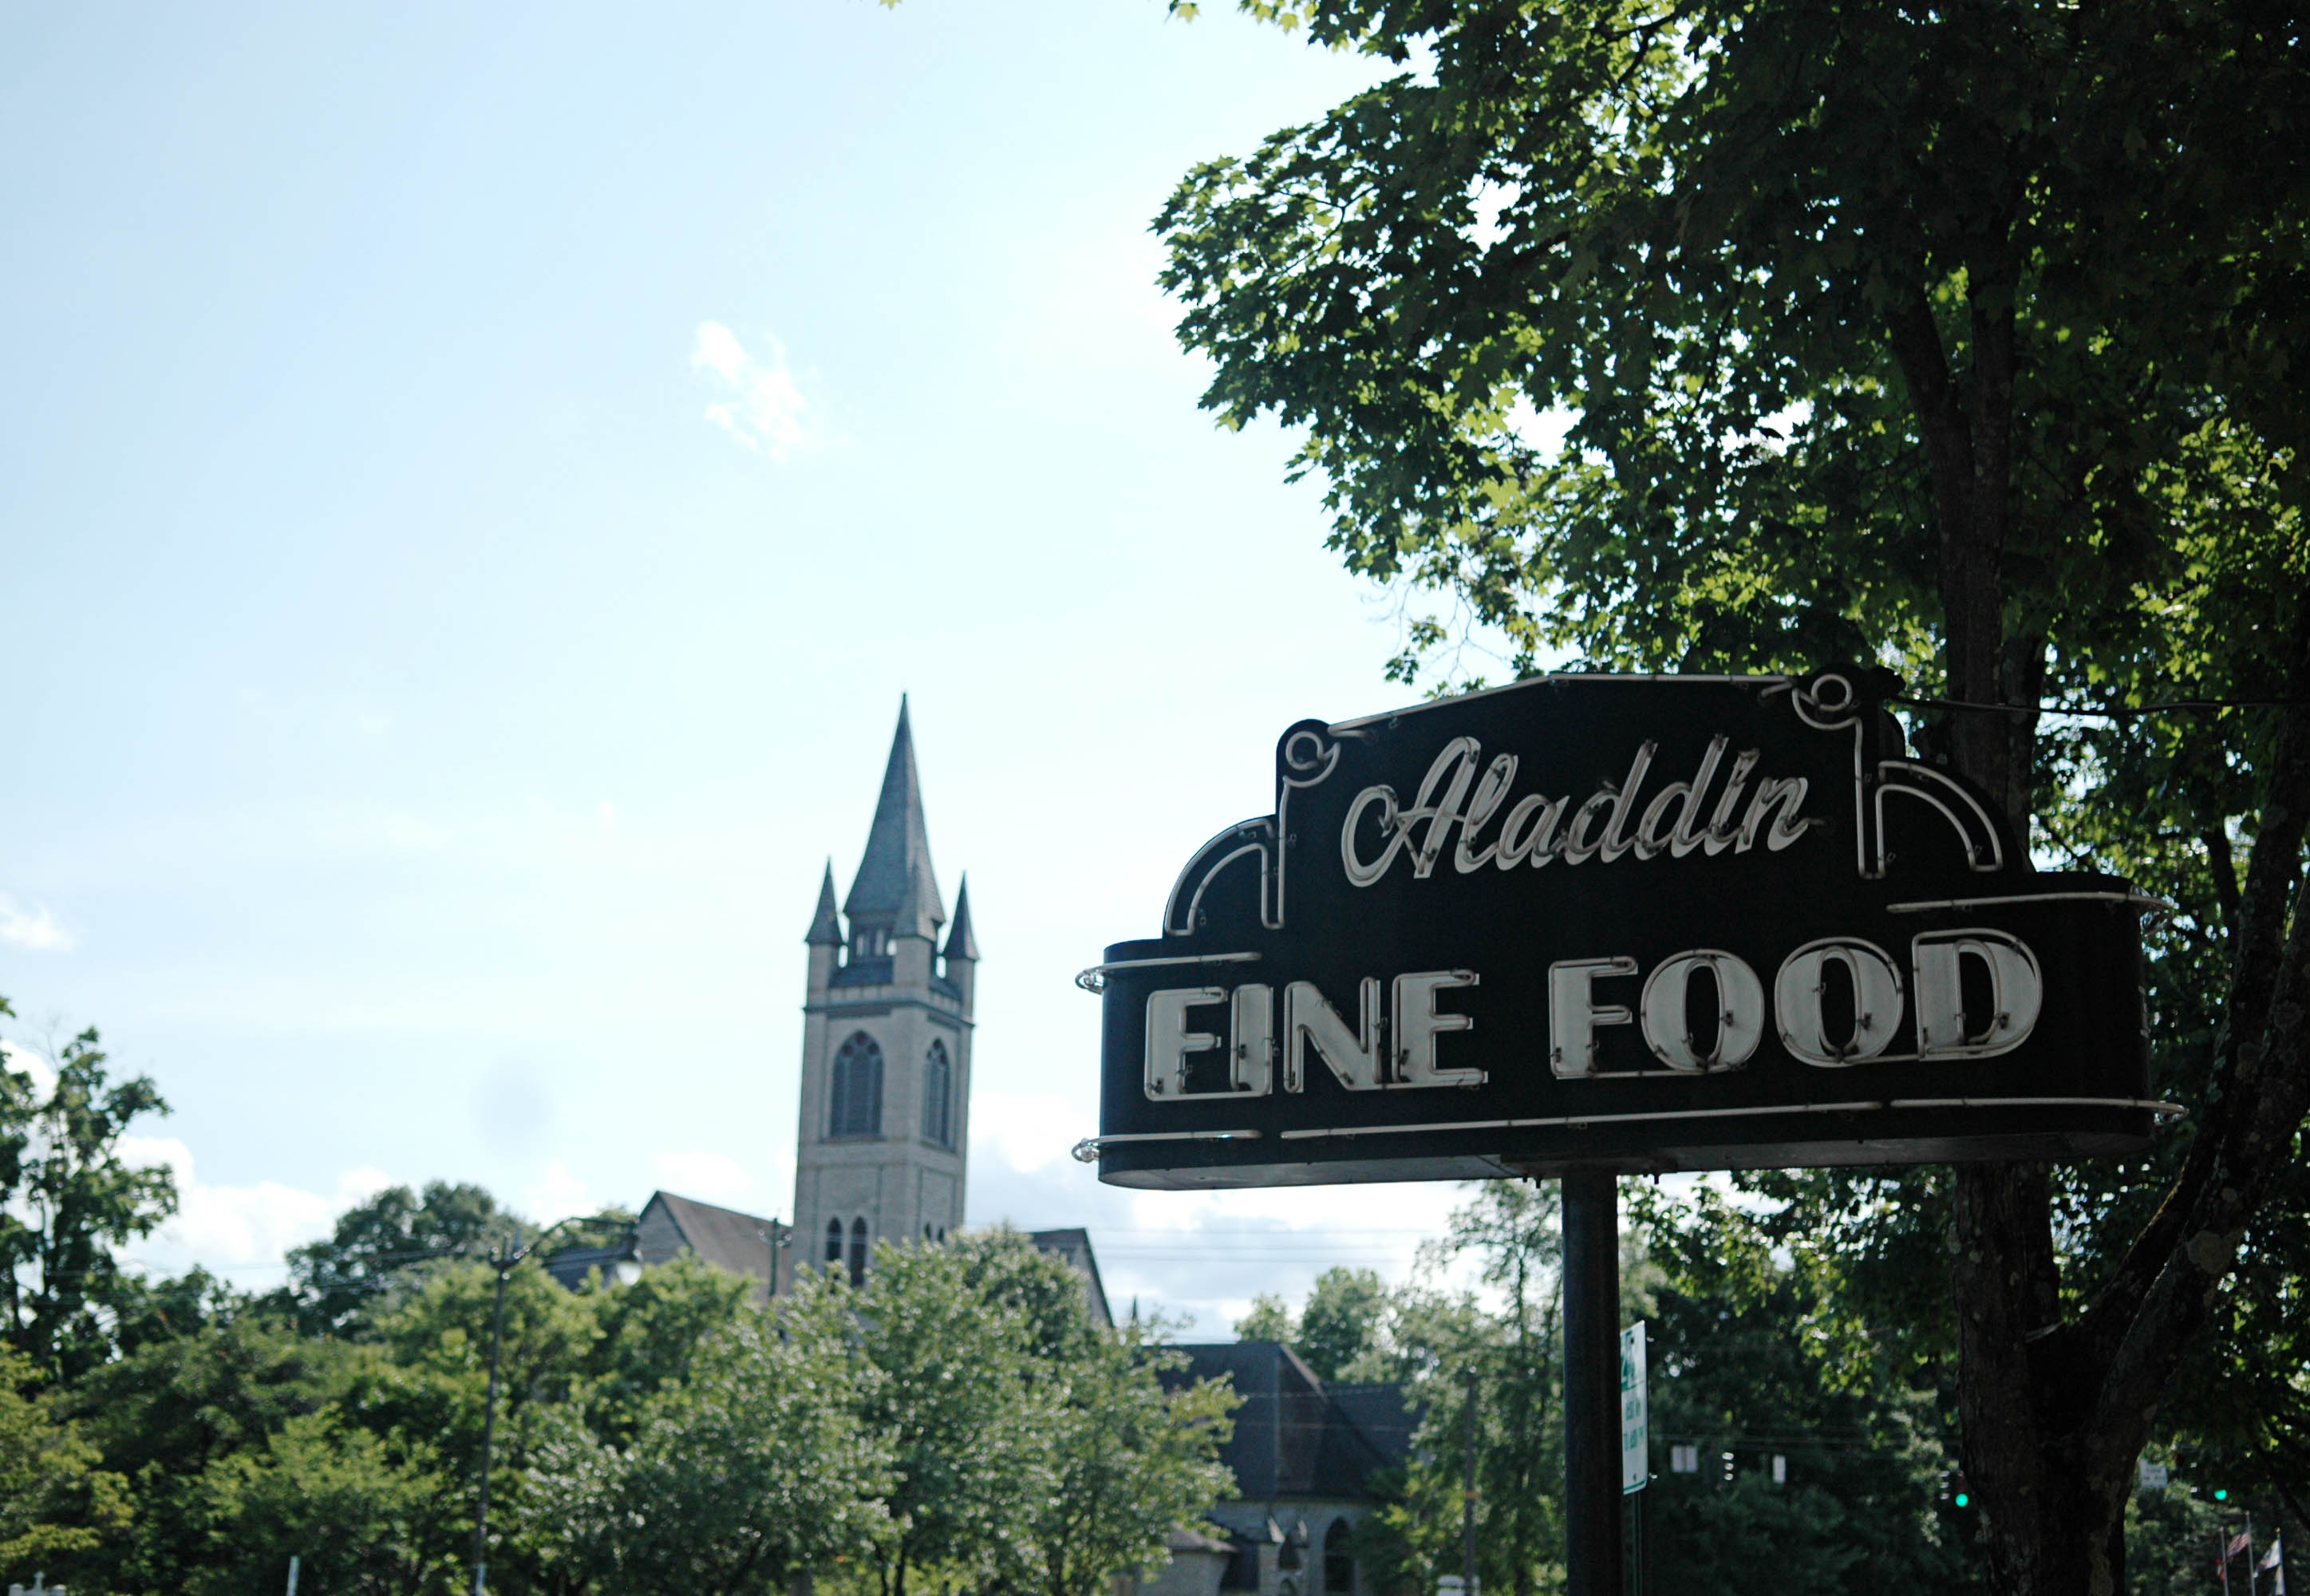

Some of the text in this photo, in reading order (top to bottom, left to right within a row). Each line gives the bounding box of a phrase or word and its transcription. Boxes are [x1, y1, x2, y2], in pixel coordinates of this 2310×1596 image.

[1341, 735, 1819, 887] Aladdin
[1144, 927, 2043, 1102] FINE FOOD
